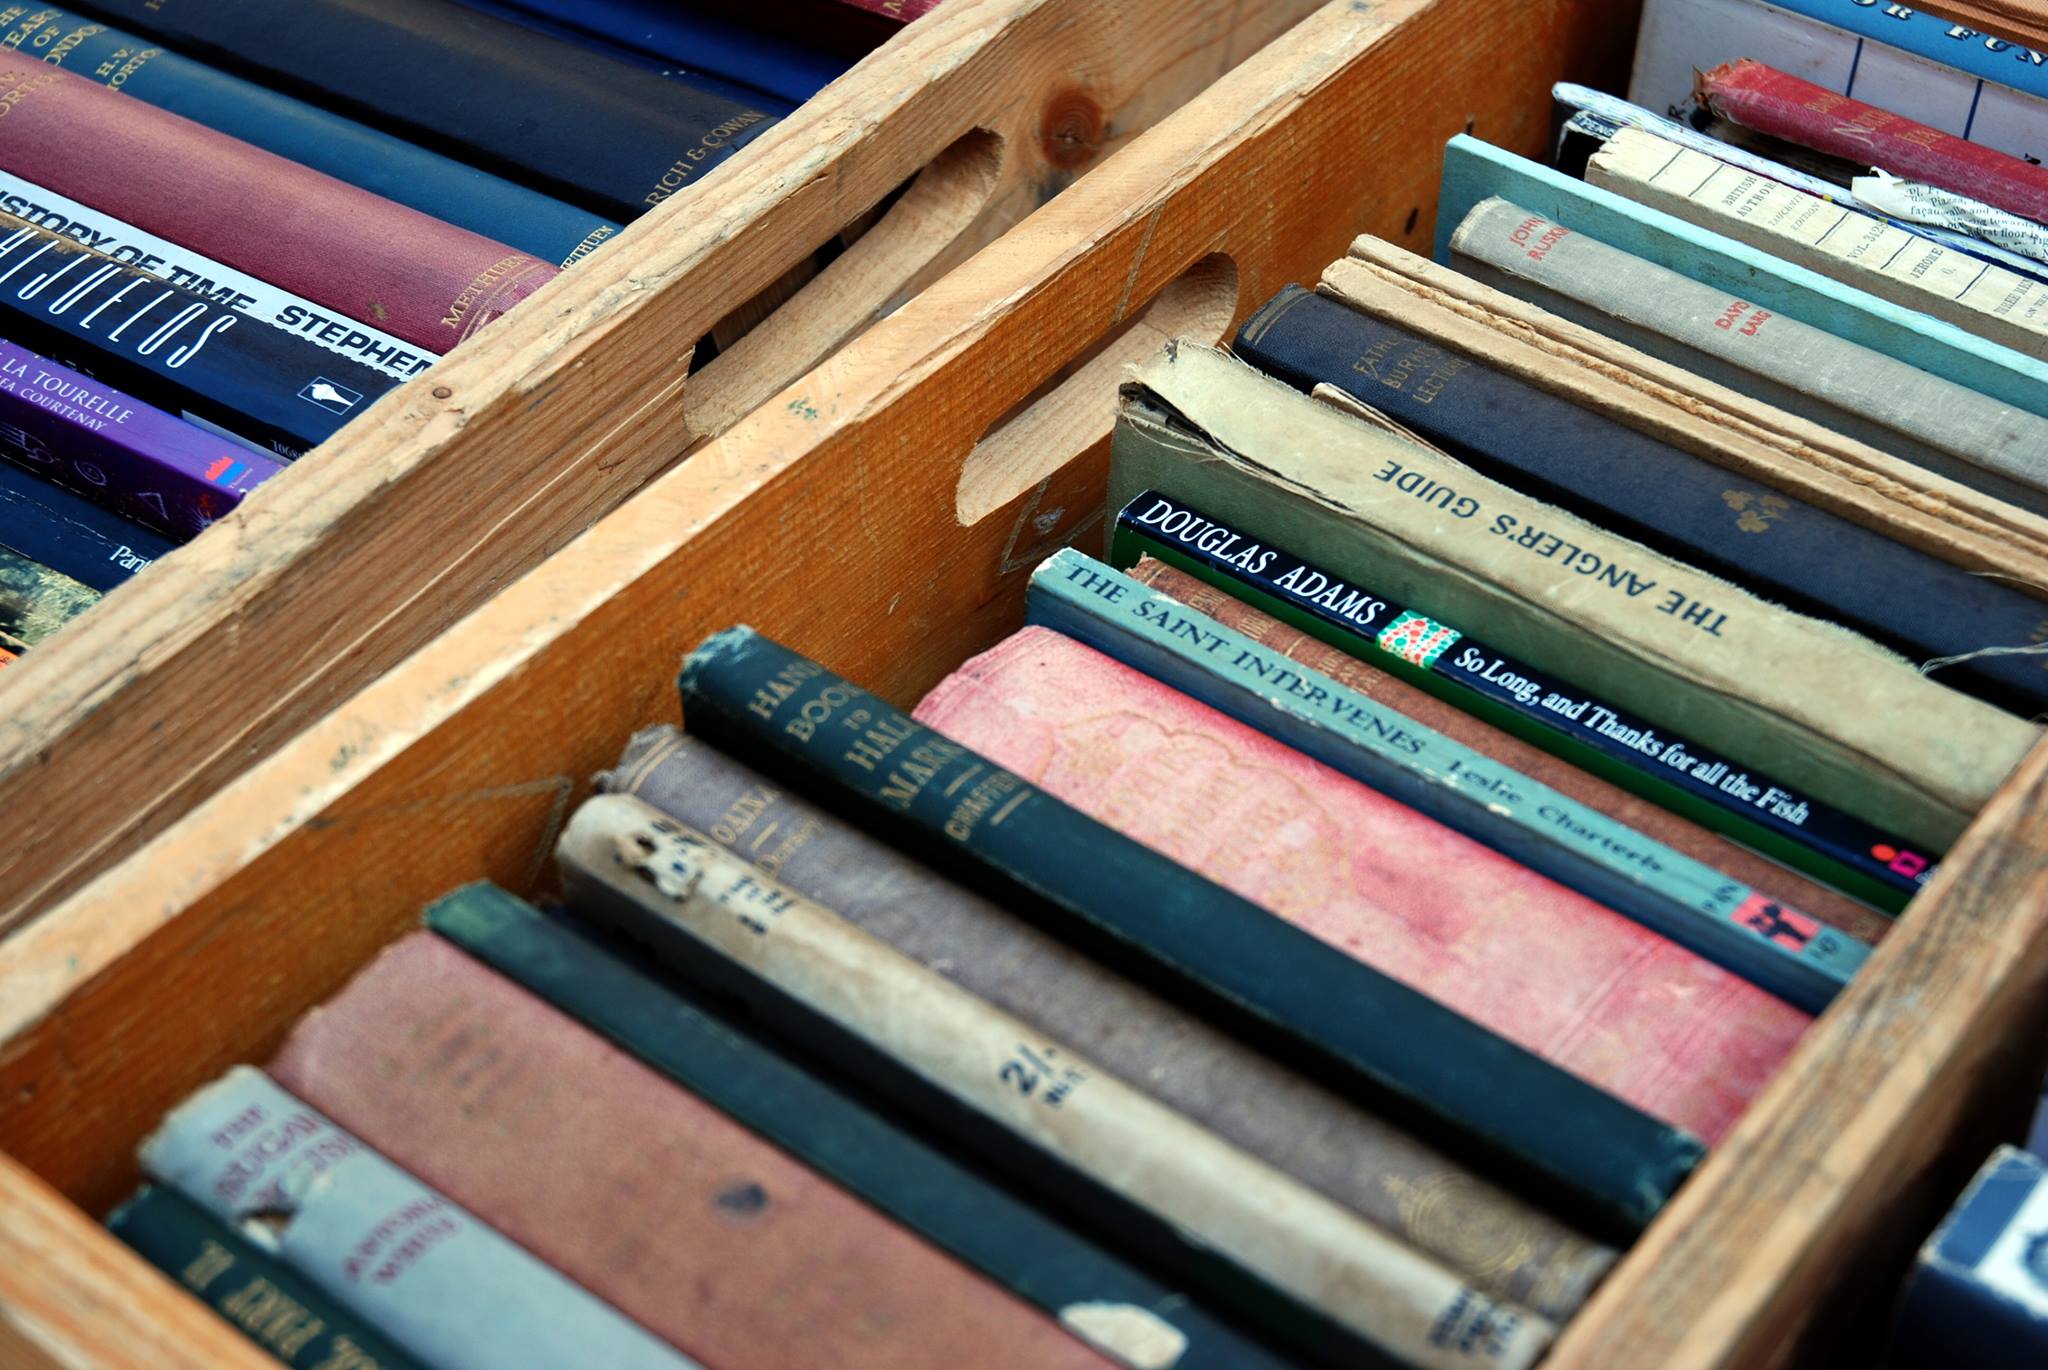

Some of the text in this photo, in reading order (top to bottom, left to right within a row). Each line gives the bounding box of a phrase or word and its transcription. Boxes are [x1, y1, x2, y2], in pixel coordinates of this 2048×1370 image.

[644, 160, 694, 206] RICH
[686, 148, 706, 161] &
[1910, 247, 1943, 280] JEROME
[2000, 227, 2026, 238] floor
[440, 254, 529, 329] METHUEN
[2, 358, 134, 424] LA TOURELLE
[20, 388, 107, 431] COURTENAY
[1372, 459, 1730, 638] THE ANGLER'S GUIDE
[1065, 563, 1129, 605] THE
[1132, 599, 1231, 653] SAINT
[1230, 650, 1428, 756] INTERVENES
[1137, 499, 1811, 826] DOUGLAS ADAMS So Long, and Thanks for all the Fish
[1447, 759, 1665, 875] Leslie Charteris
